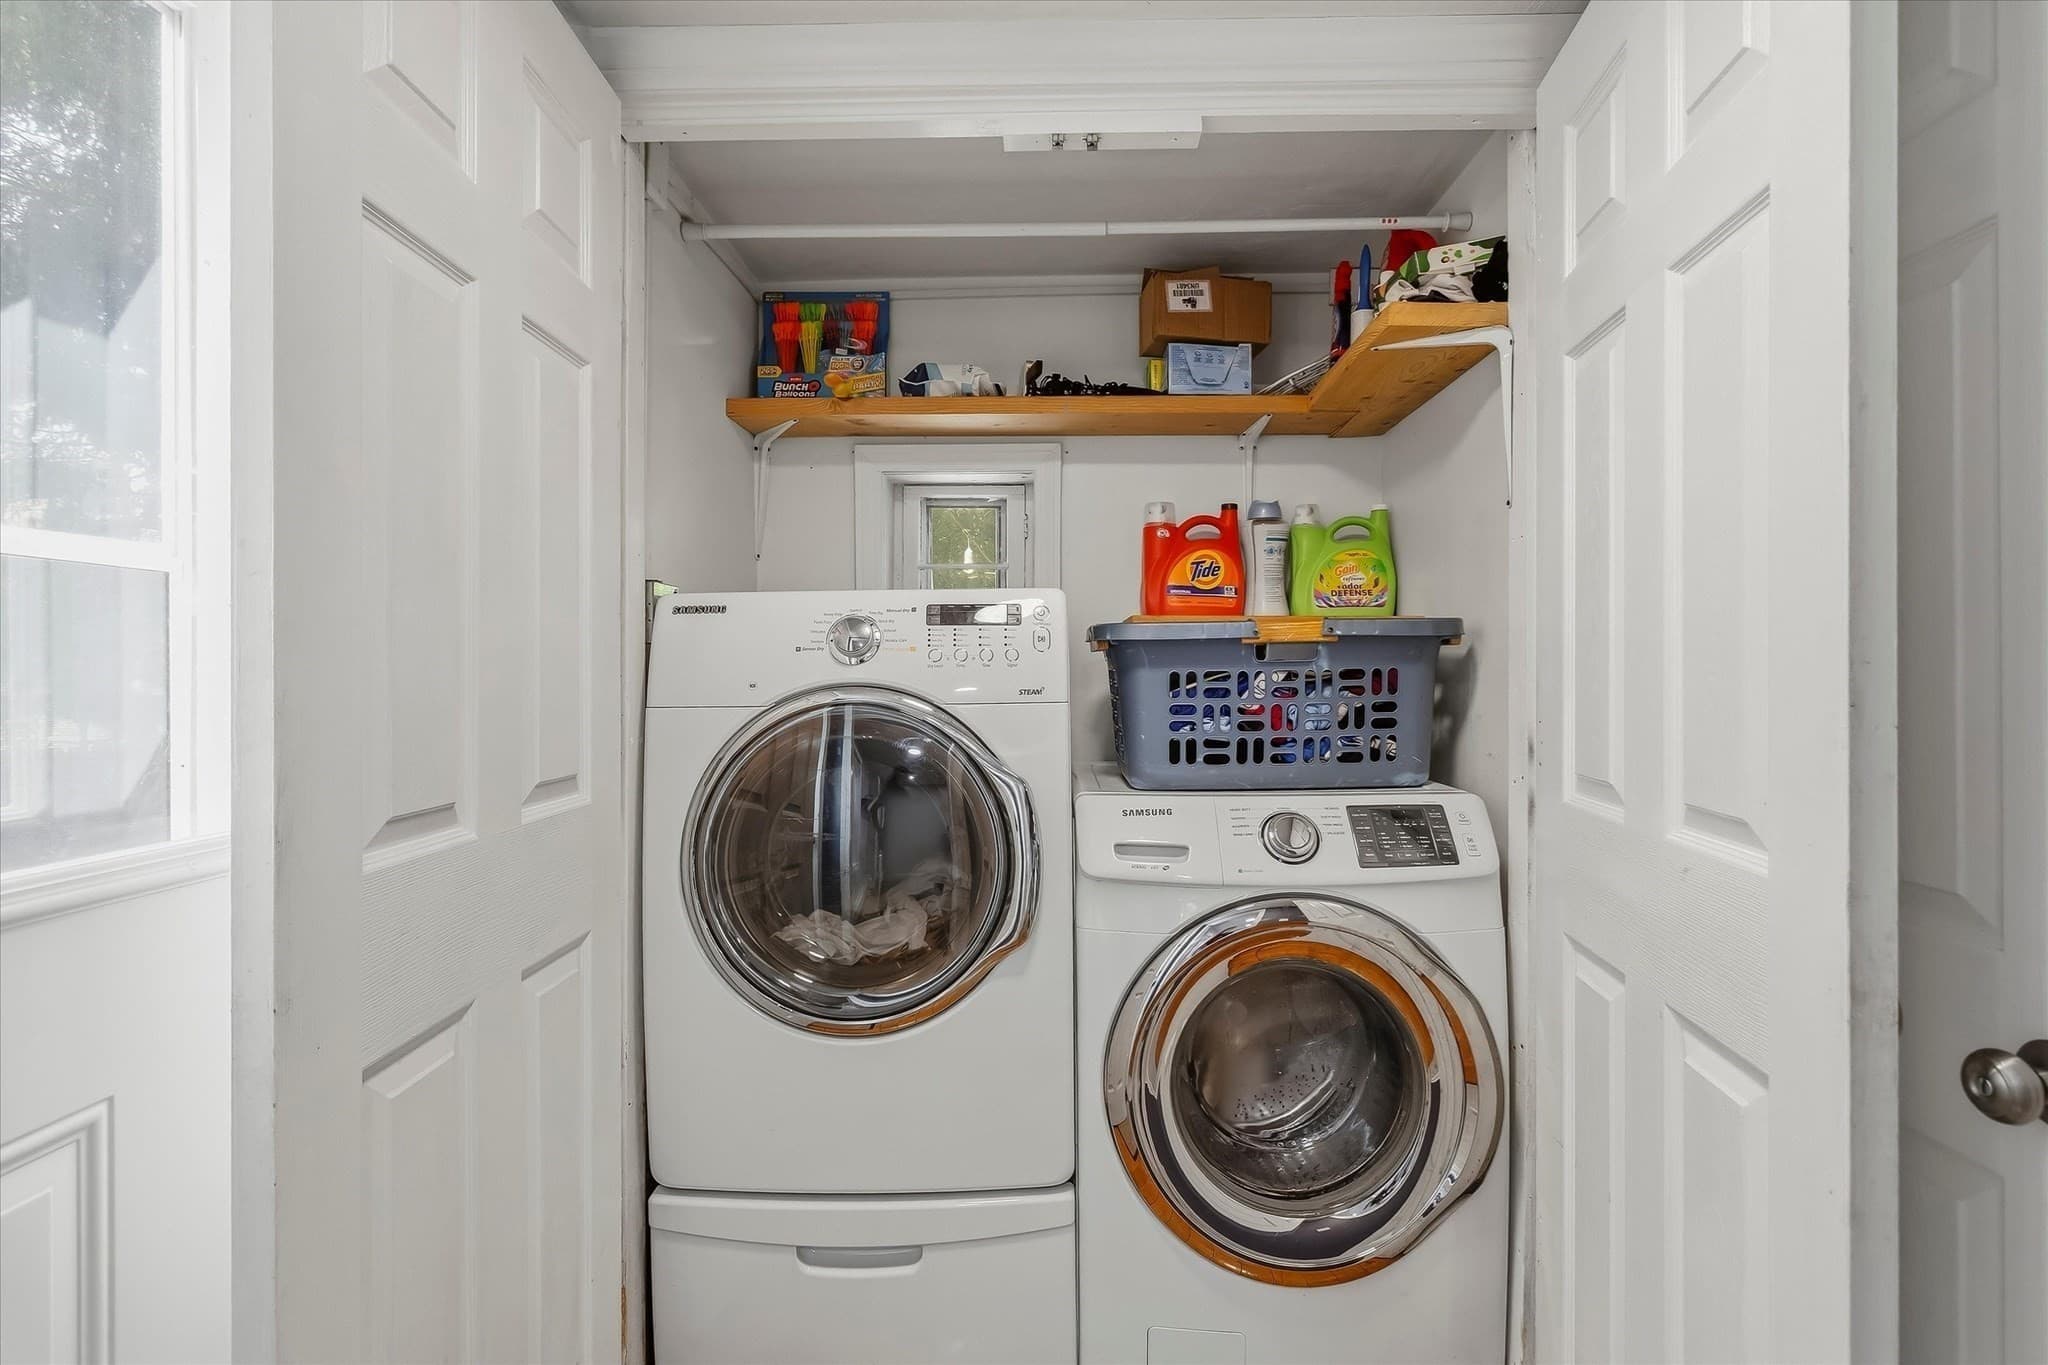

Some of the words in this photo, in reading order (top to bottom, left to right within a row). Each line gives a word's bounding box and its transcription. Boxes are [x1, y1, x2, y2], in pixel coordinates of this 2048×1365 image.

[774, 382, 809, 391] BUNCH
[1190, 560, 1221, 582] Tide
[1334, 563, 1358, 577] Gain
[1331, 589, 1374, 597] DEFENSE
[672, 605, 727, 615] SAMSUNG
[1122, 808, 1173, 817] SAMSUNG
